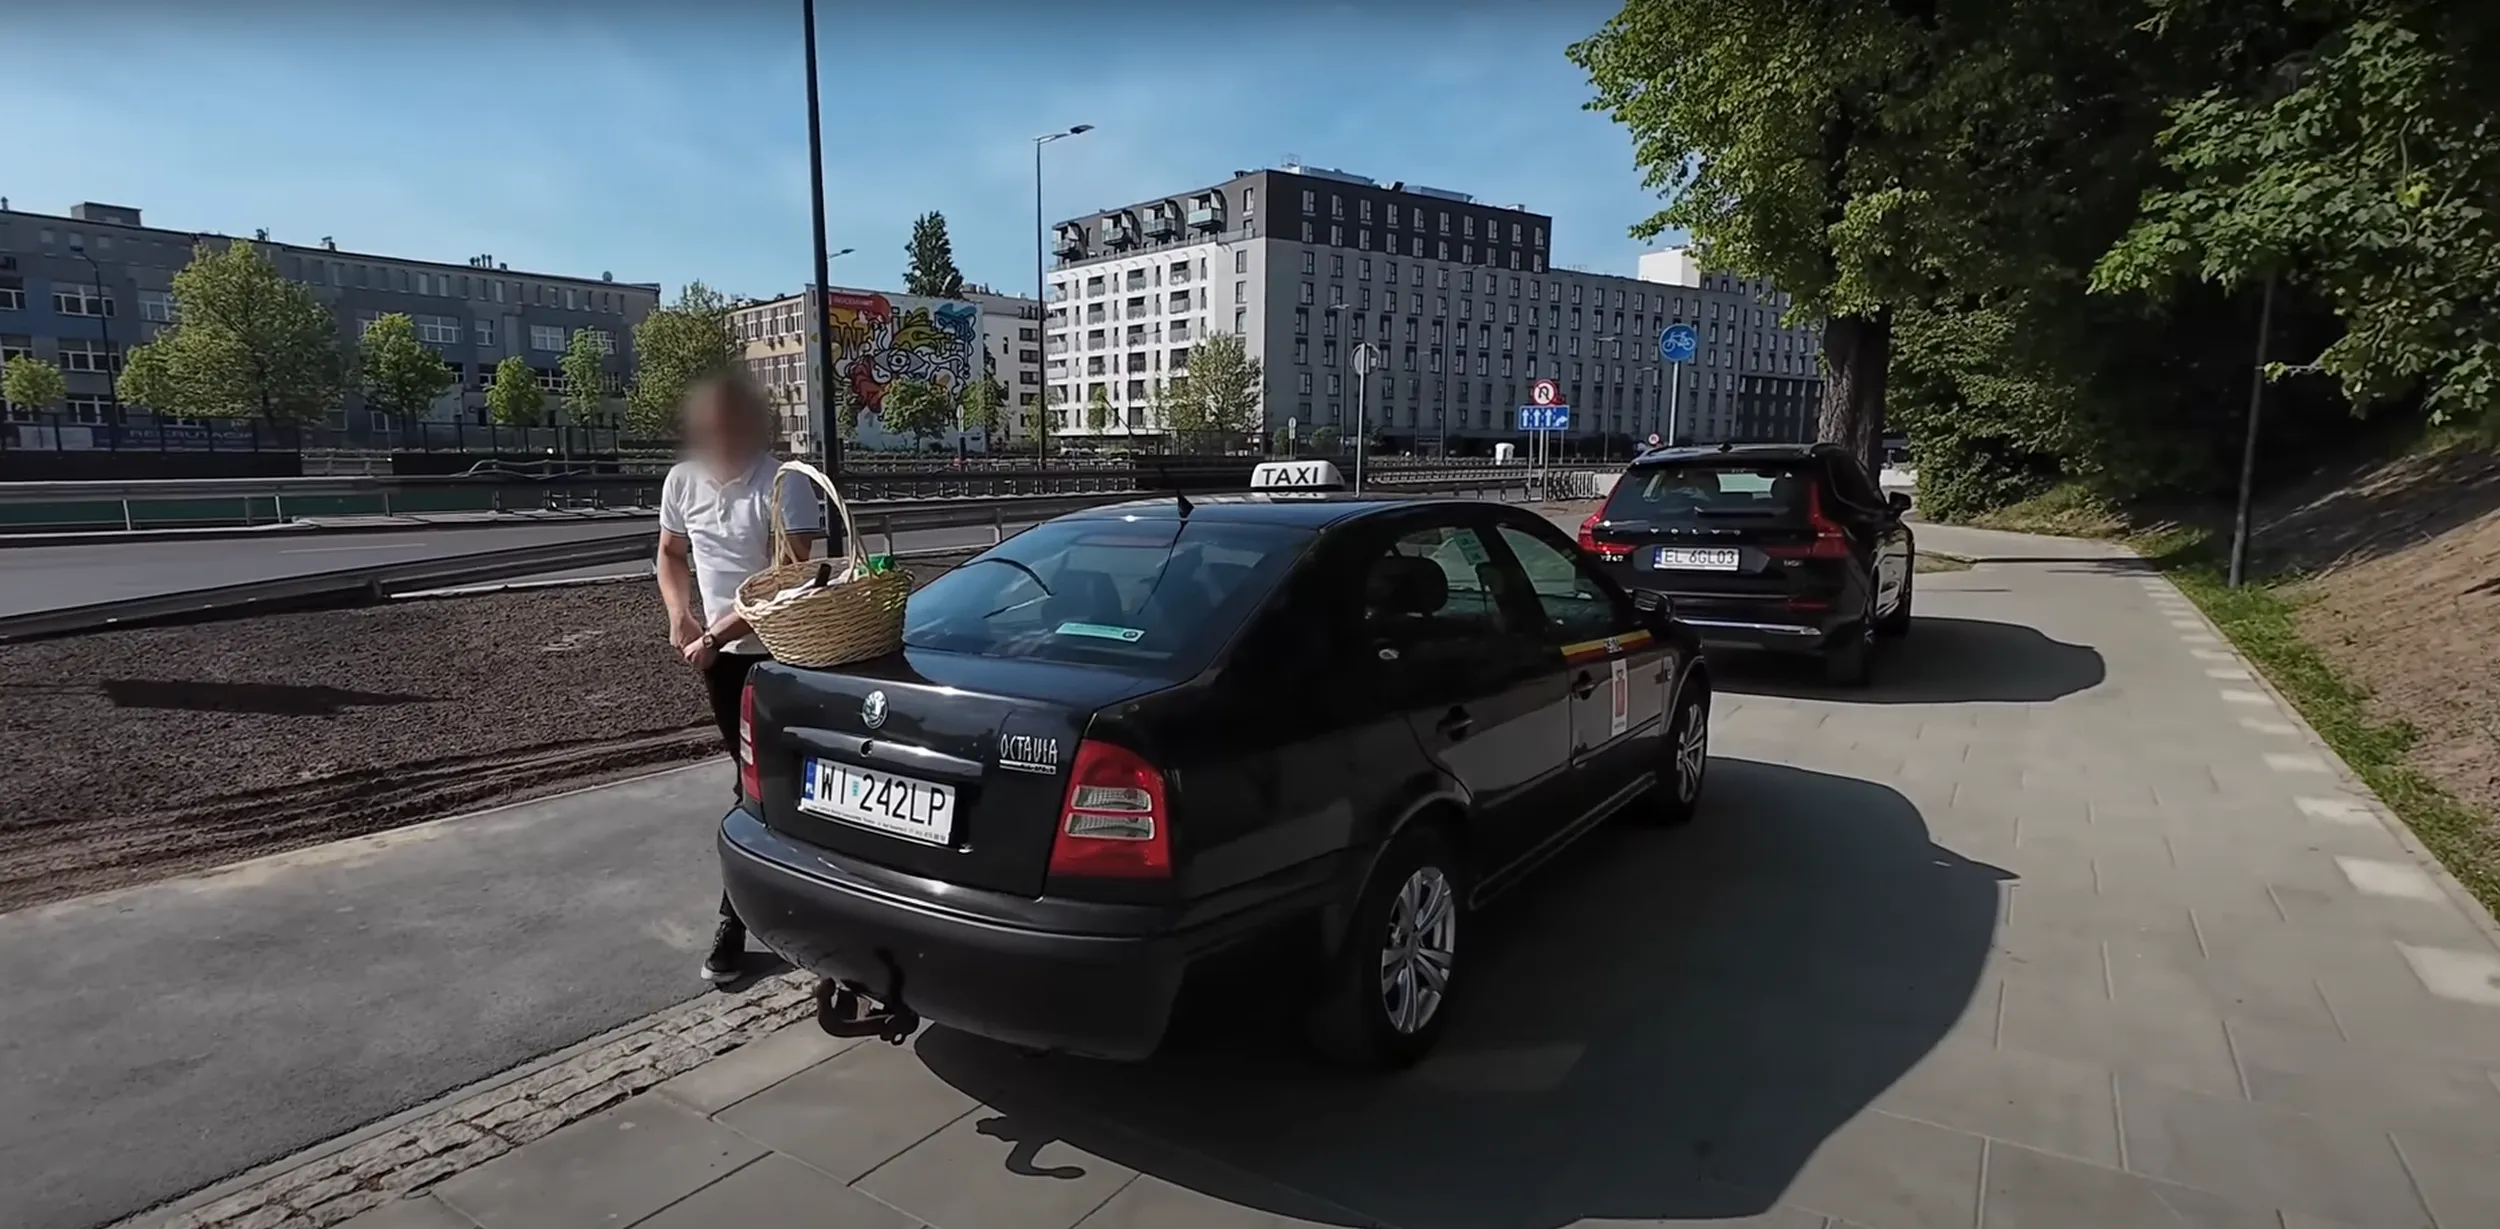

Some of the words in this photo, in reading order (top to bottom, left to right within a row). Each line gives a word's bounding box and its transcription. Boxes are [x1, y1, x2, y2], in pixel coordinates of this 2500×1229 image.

[1262, 467, 1319, 485] TAXI
[1650, 527, 1742, 536] VOLVO
[1665, 550, 1683, 563] EL
[1690, 550, 1736, 564] 6GL03
[1000, 733, 1058, 764] OCTAVIA
[821, 764, 847, 804] WI
[859, 773, 946, 826] 242LP
